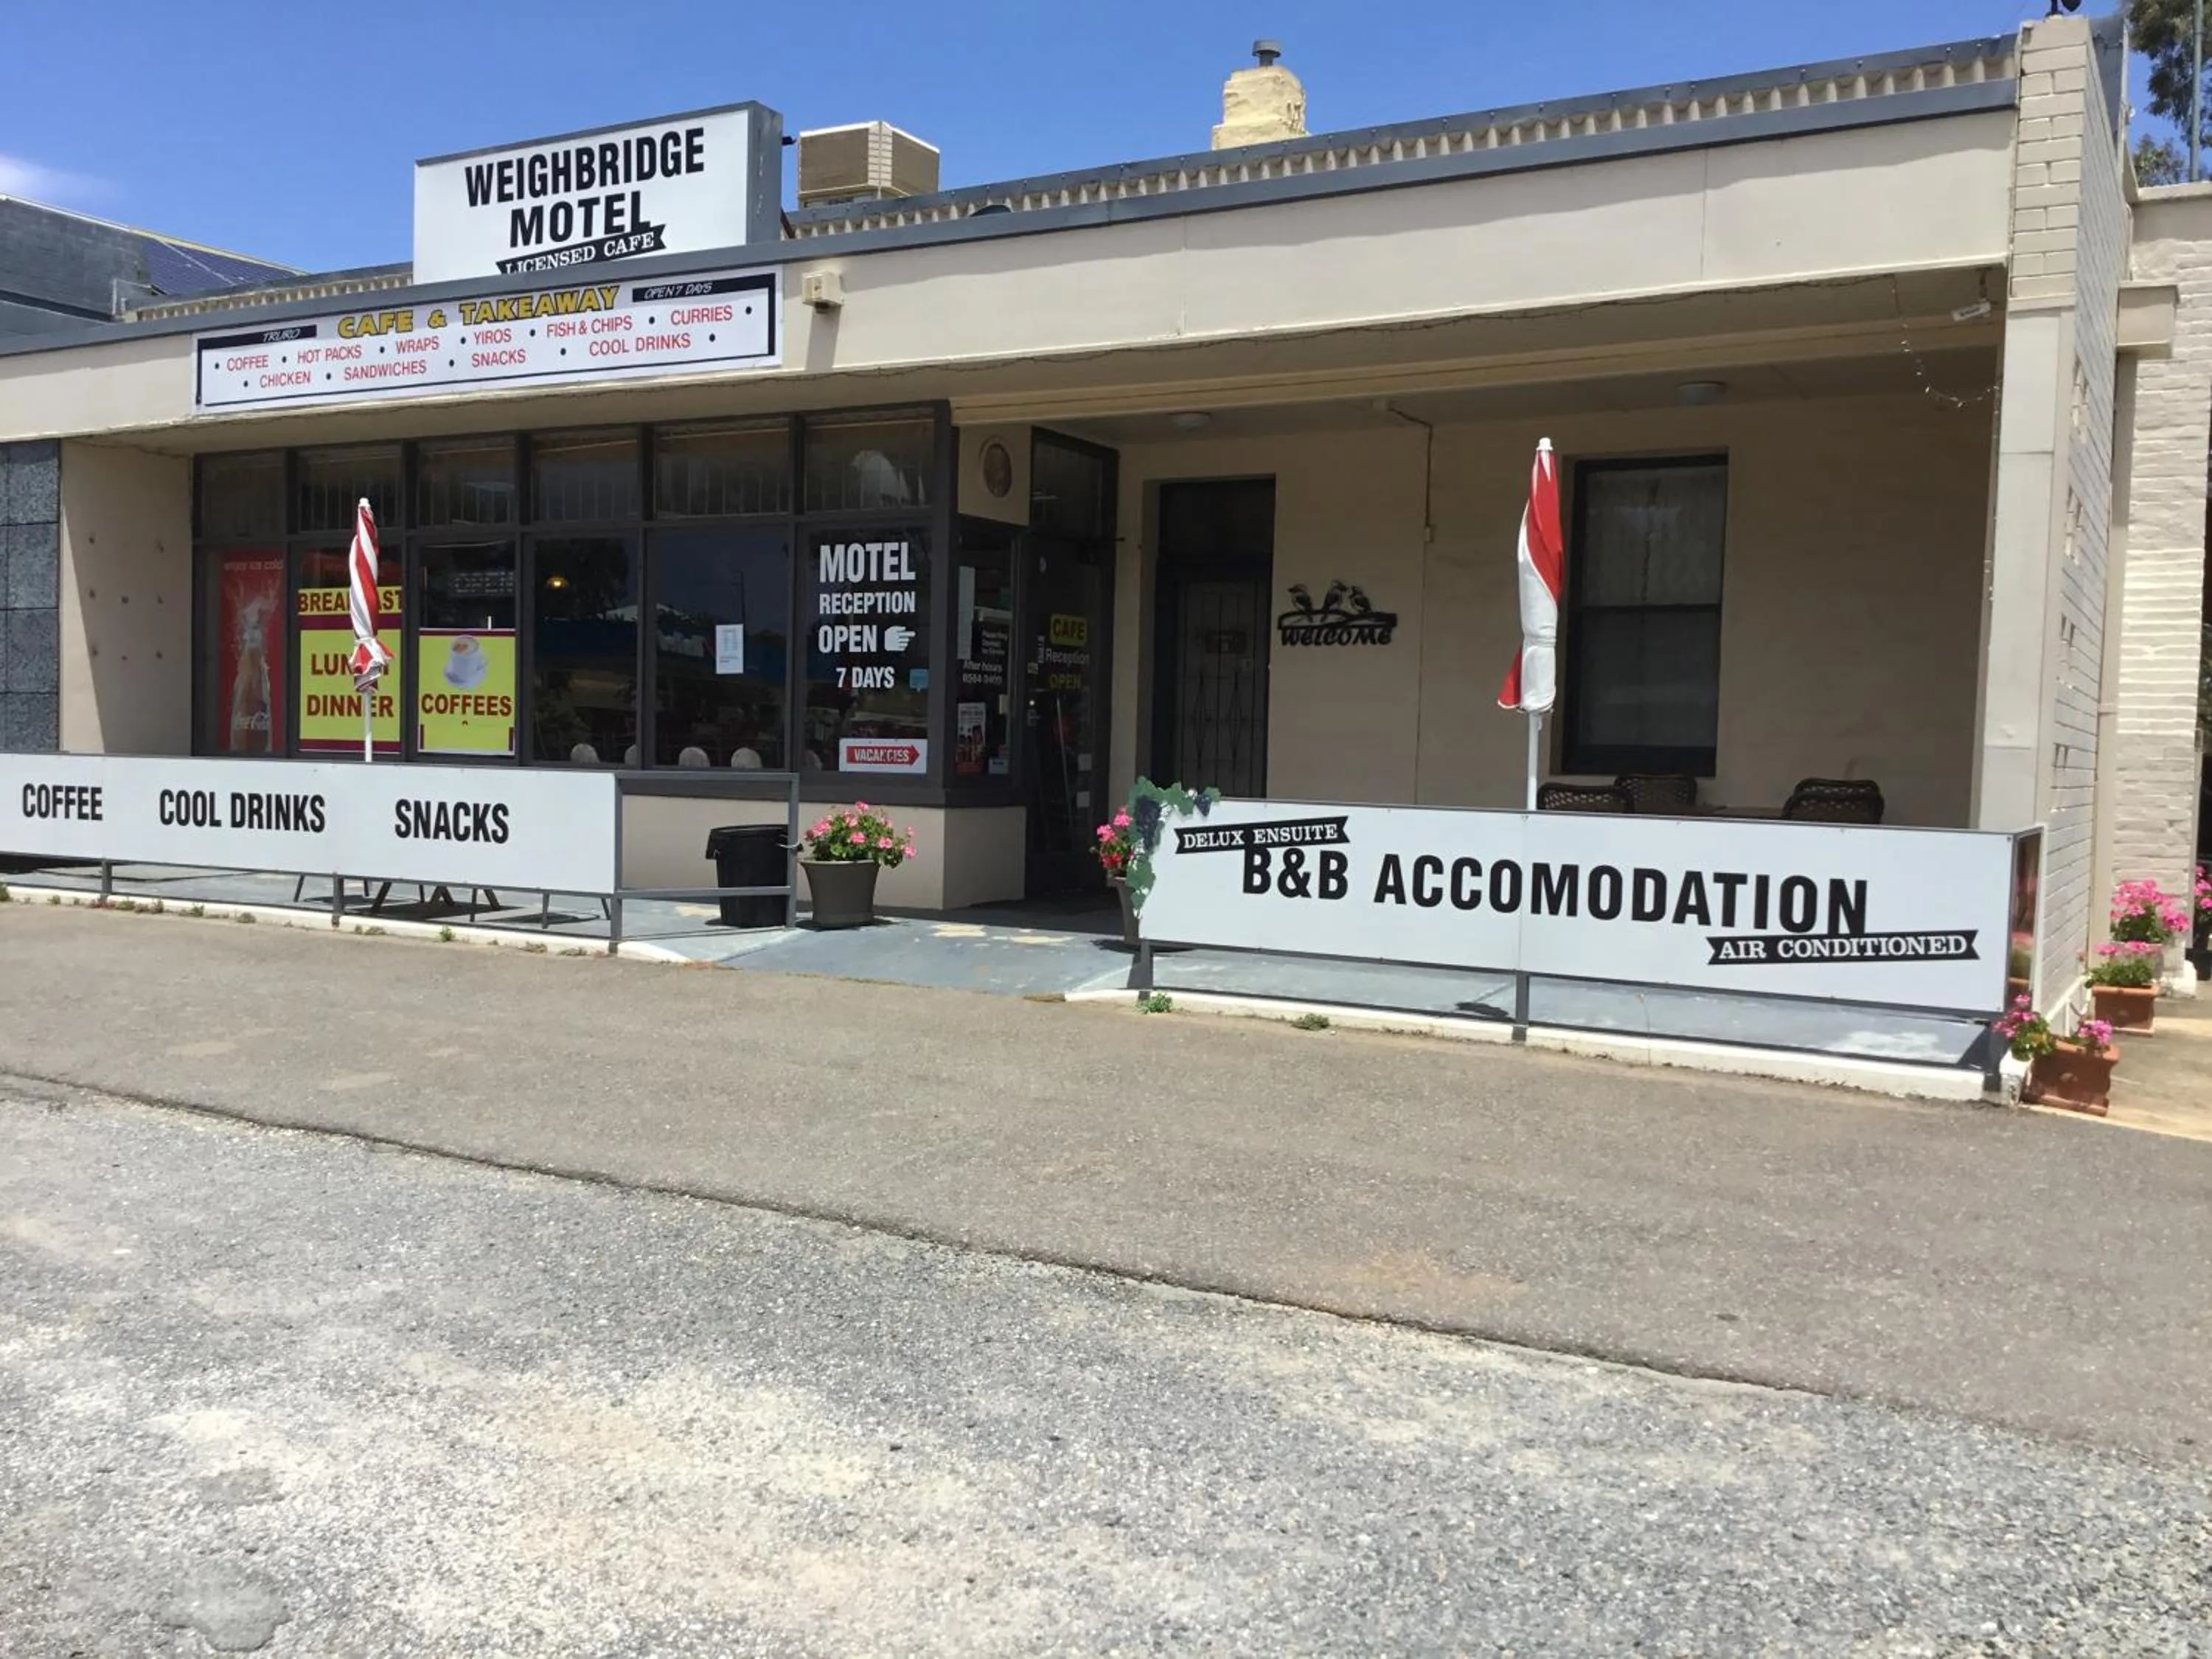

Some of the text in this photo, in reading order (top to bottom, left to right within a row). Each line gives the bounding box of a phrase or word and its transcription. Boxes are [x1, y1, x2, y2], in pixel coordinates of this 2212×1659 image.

[465, 127, 704, 207] WEIGHBRIDGE
[509, 190, 651, 248] MOTEL
[505, 232, 655, 274] LICENSED CAFE
[686, 282, 713, 296] DAYS
[337, 285, 621, 339] CAFE & TAKEAWAY
[226, 305, 733, 372] COFFEE HOT PACKS WRAPS YIROS FISH & CHIPS CURRIES
[262, 328, 301, 343] TRURO
[260, 333, 691, 388] CHICKEN SANDWICHES SNACKS COOL DRINKS
[819, 542, 917, 583] MOTEL
[298, 591, 402, 613] BREAST
[819, 591, 916, 614] RECEPTION
[818, 625, 877, 653] OPEN
[1053, 619, 1086, 640] CAFE
[311, 653, 389, 676] LUN
[1046, 647, 1091, 667] Reception
[835, 667, 895, 689] 7 DAYS
[1049, 674, 1083, 690] OPEN
[307, 694, 394, 717] DINNER
[421, 694, 512, 717] COFFEES
[854, 748, 910, 762] VACANCIES
[22, 783, 509, 844] COFFEE COOL DRINKS SNACKS
[1183, 823, 1338, 849] DELUX ENSUITE
[1242, 847, 1868, 935] B&B ACCOMODATION
[1719, 935, 1968, 959] AIR CONDITIONED
